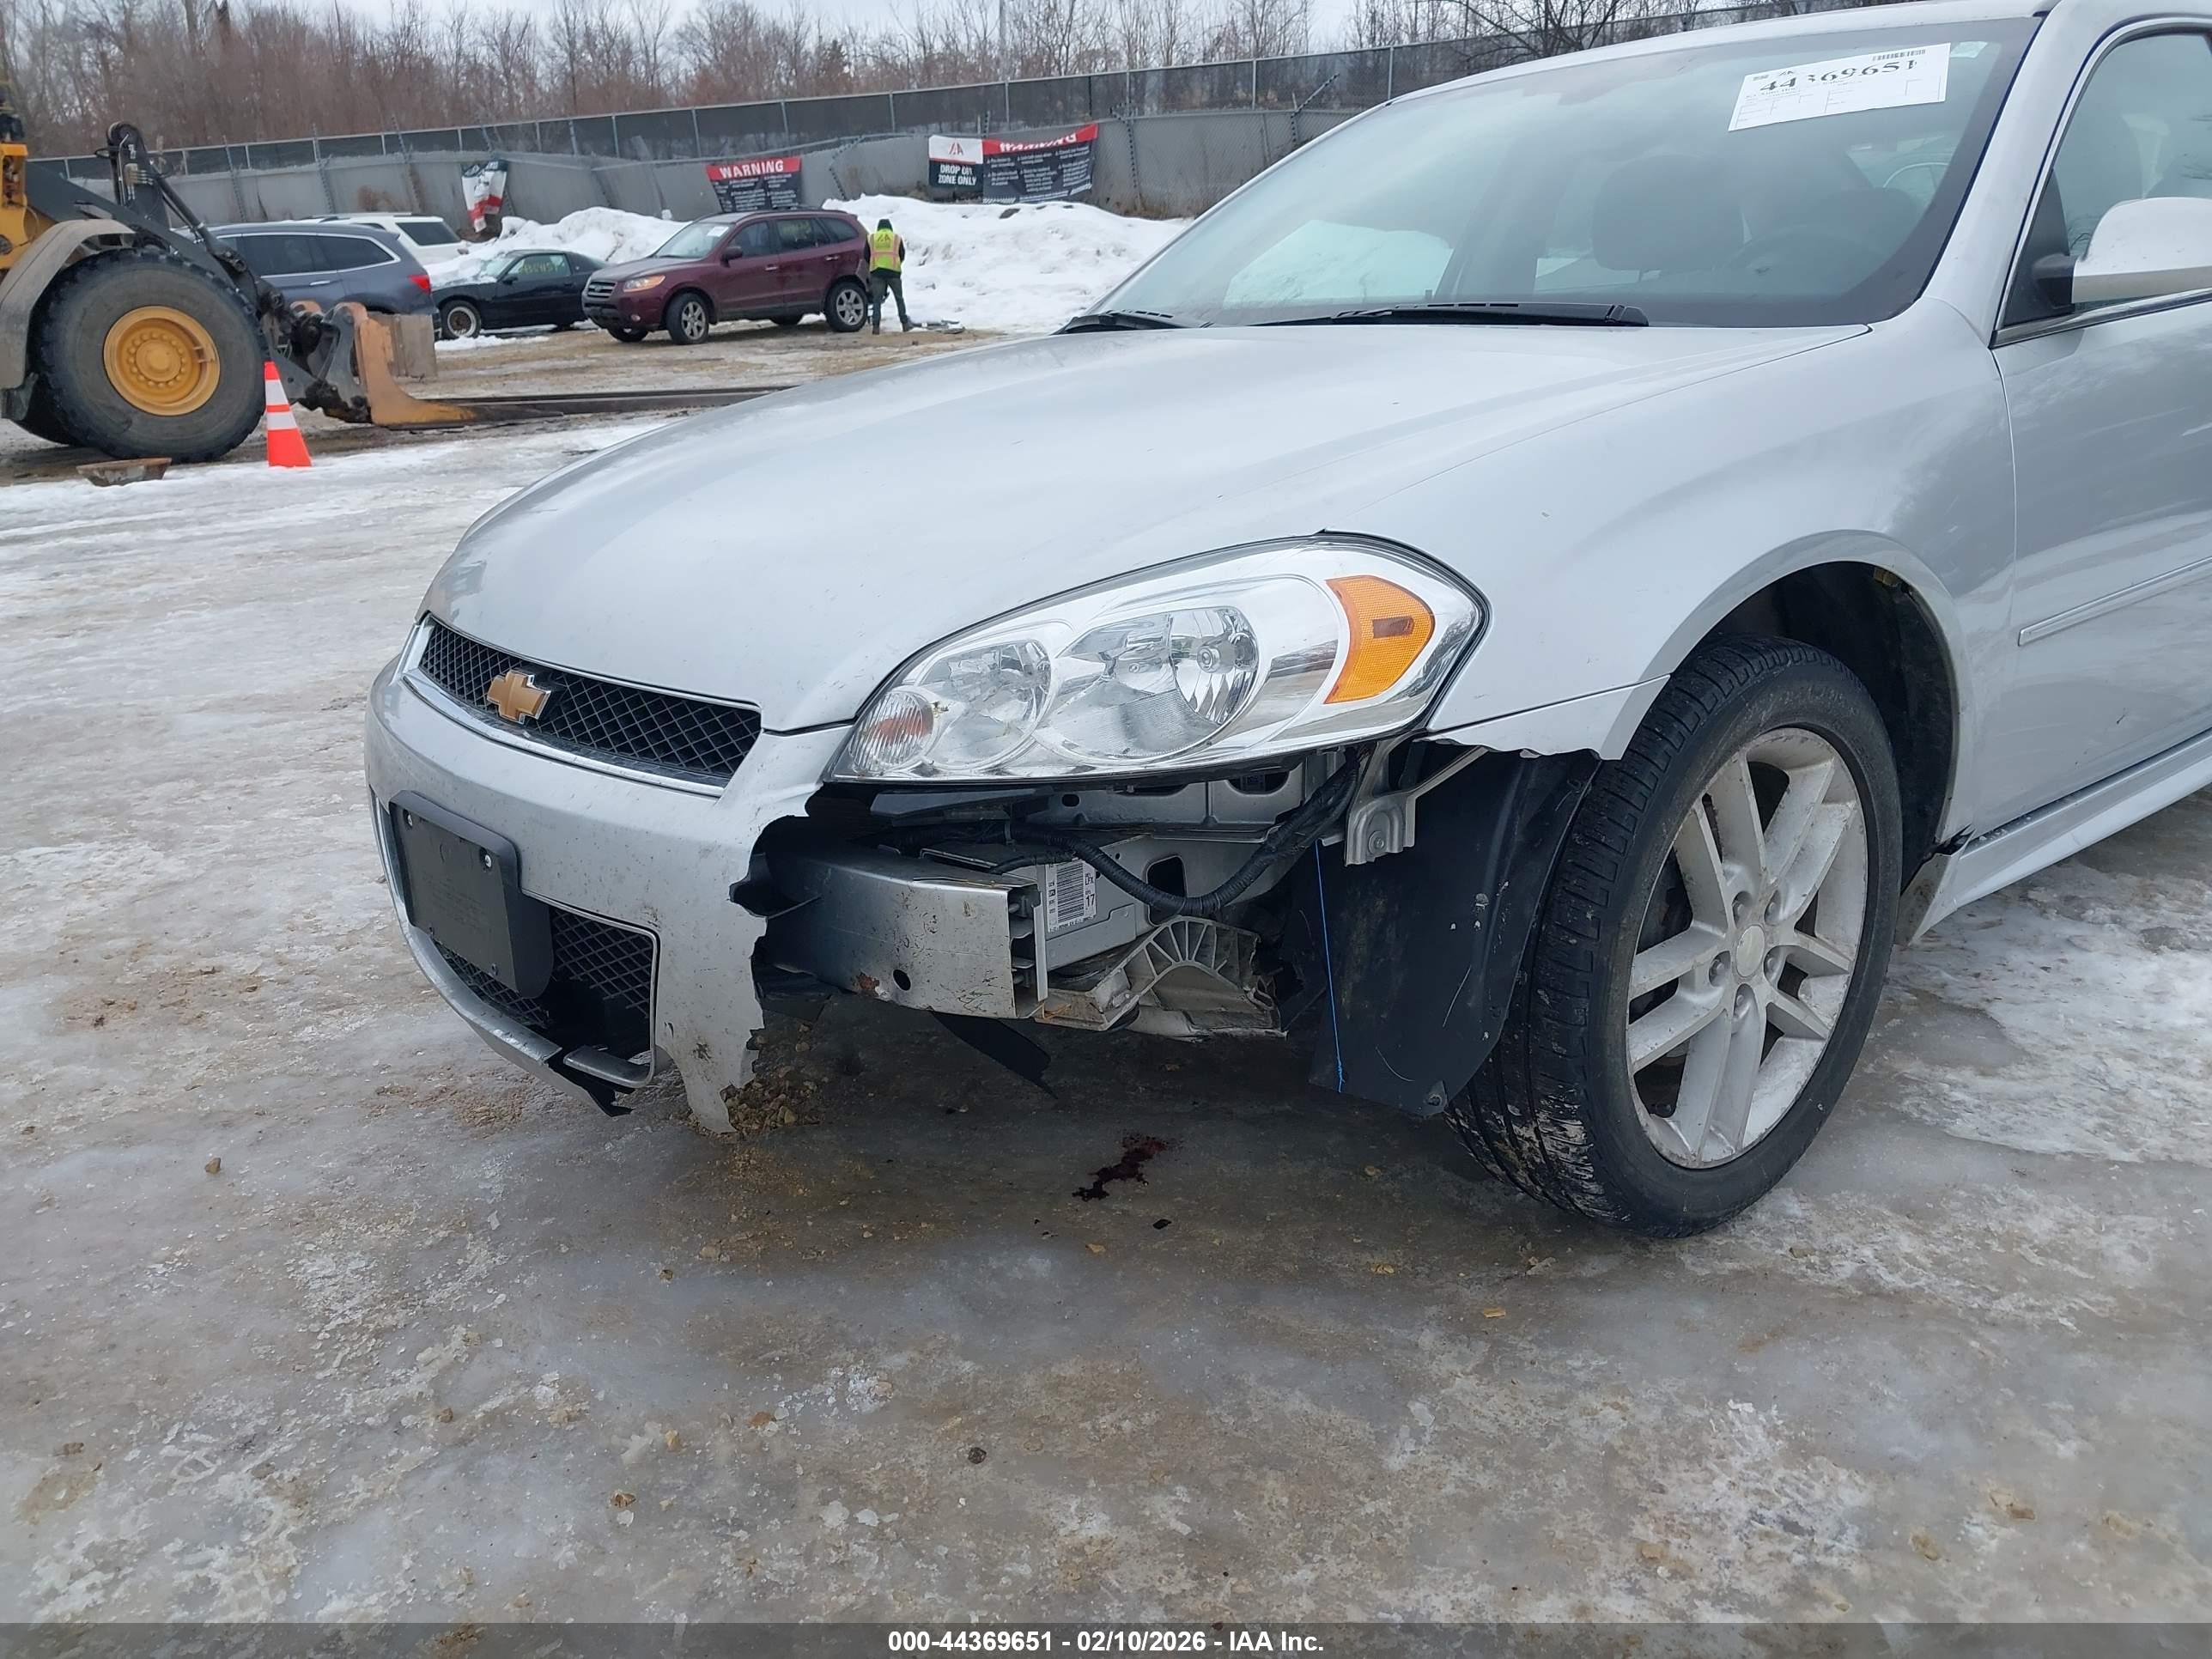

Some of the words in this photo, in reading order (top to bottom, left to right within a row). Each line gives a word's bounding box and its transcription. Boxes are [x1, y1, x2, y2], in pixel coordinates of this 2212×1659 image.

[720, 160, 783, 179] WARNING
[940, 164, 961, 175] DROP
[938, 174, 957, 185] ZONE
[957, 175, 977, 186] ONLY
[1085, 894, 1095, 908] 17
